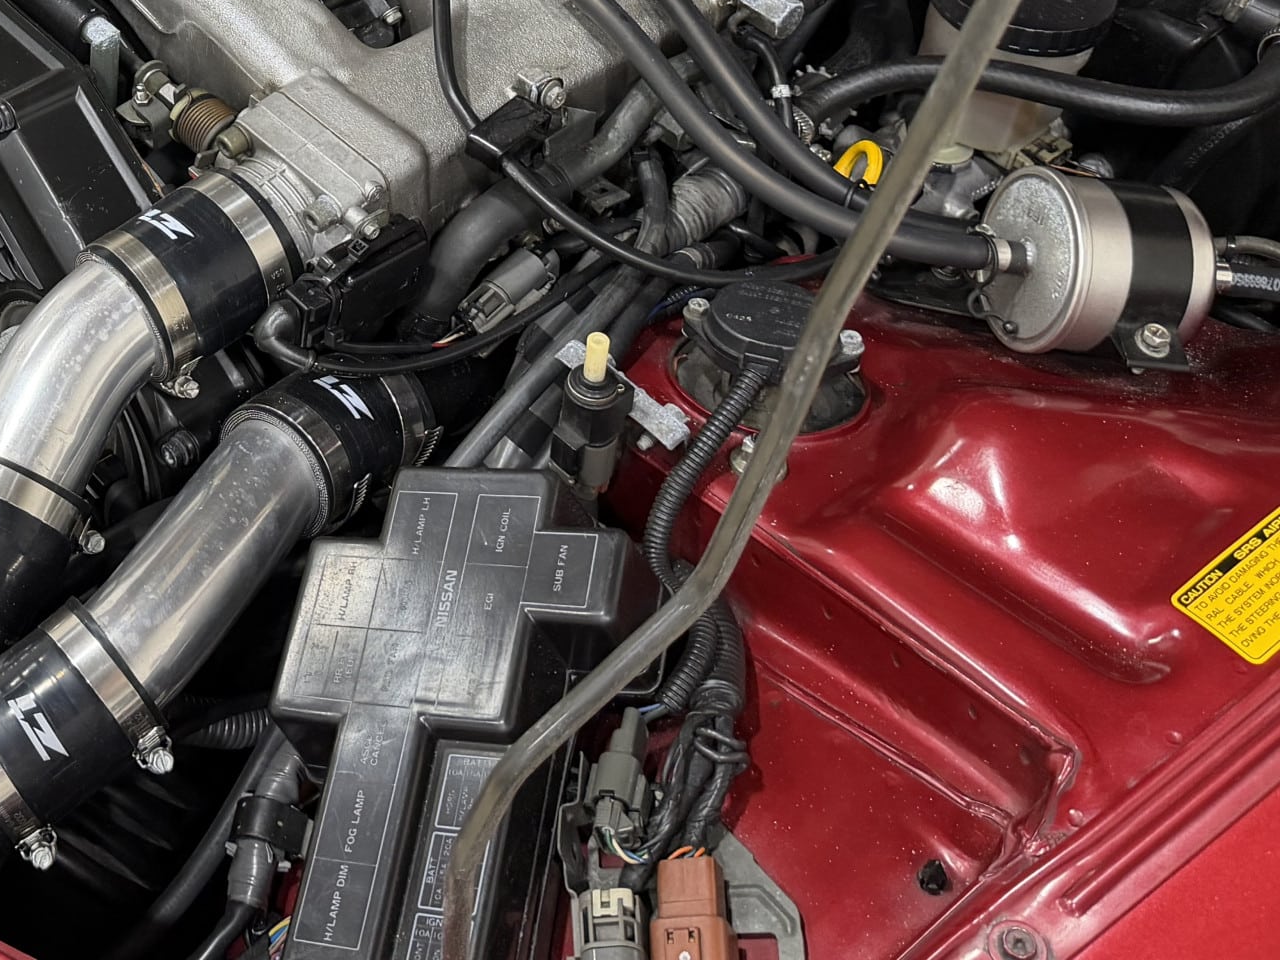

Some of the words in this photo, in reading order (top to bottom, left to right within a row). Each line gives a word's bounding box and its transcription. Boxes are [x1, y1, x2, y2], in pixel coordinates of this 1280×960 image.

[410, 512, 428, 555] H/LAMP
[419, 495, 432, 511] LH
[497, 506, 512, 533] COIL
[494, 533, 506, 553] IGN
[556, 543, 570, 566] FAN
[1179, 567, 1224, 606] CAUTION
[1232, 534, 1263, 561] SRS
[1262, 517, 1280, 538] AIR
[551, 568, 565, 592] SUB
[1194, 599, 1208, 612] TO
[1206, 580, 1231, 602] AVOID
[1228, 548, 1270, 584] DAMAGING
[1205, 604, 1224, 621] RAL
[1254, 557, 1280, 580] WHICH
[434, 567, 458, 628] NISSAN
[482, 590, 495, 610] EGI
[1216, 612, 1236, 630] THE
[1232, 587, 1266, 616] SYSTEM
[1228, 621, 1247, 639] THE
[349, 788, 367, 824] LAMP
[343, 826, 358, 853] FOG
[424, 855, 439, 884] BATT
[322, 890, 344, 941] H/LAMP
[335, 862, 350, 887] DIM
